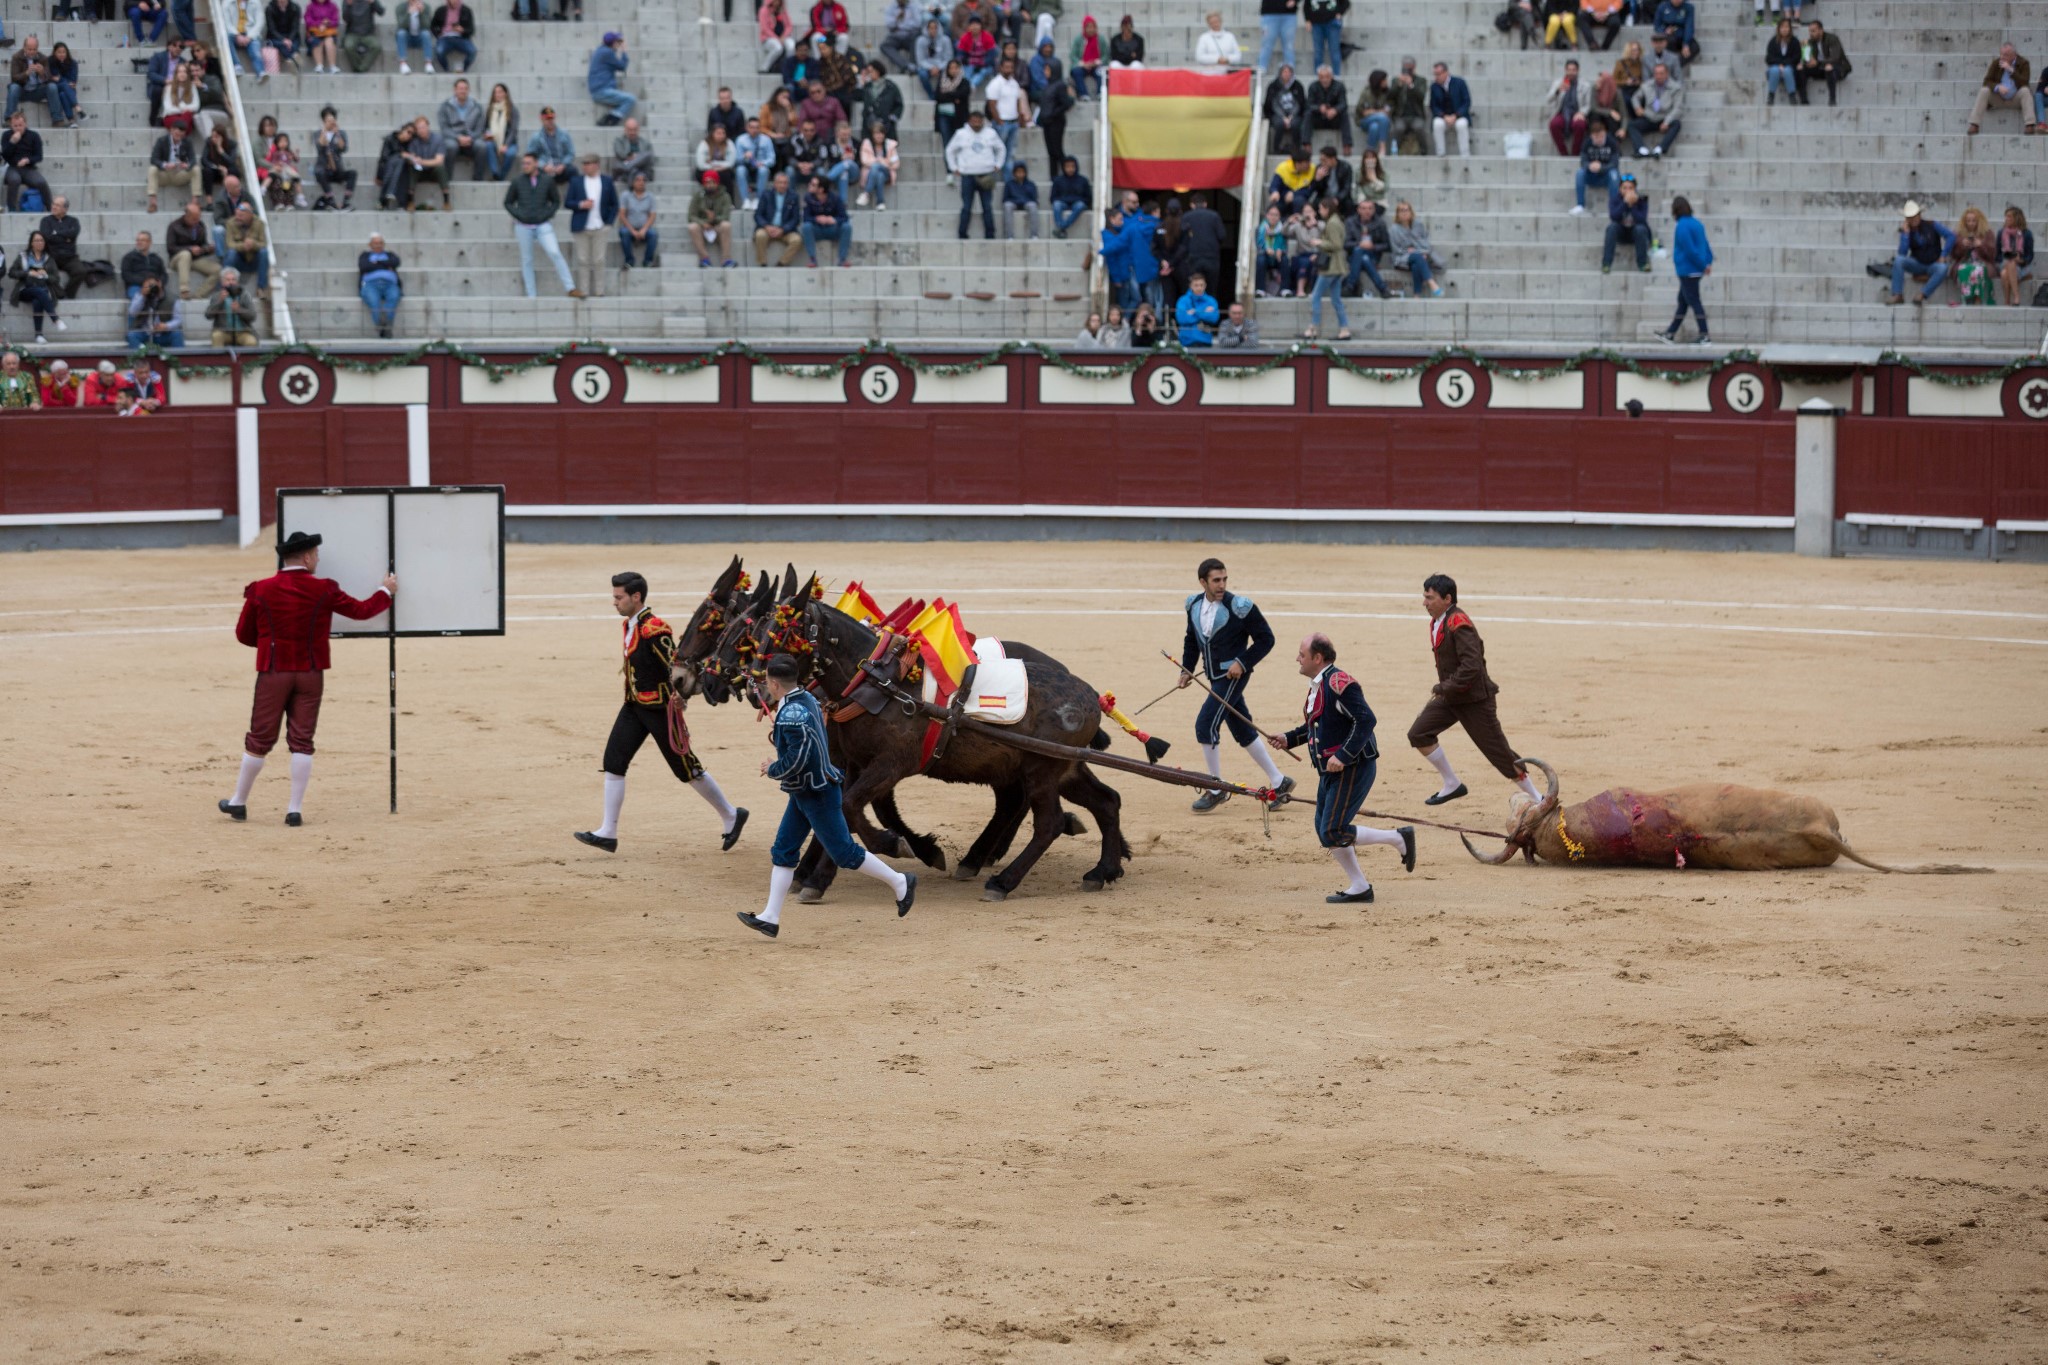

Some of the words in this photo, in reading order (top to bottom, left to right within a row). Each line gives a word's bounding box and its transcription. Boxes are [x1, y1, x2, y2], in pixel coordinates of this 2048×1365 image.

[583, 370, 600, 399] 5
[872, 370, 889, 399] 5
[1160, 371, 1177, 400] 5
[1447, 374, 1464, 403] 5
[1737, 378, 1755, 408] 5
